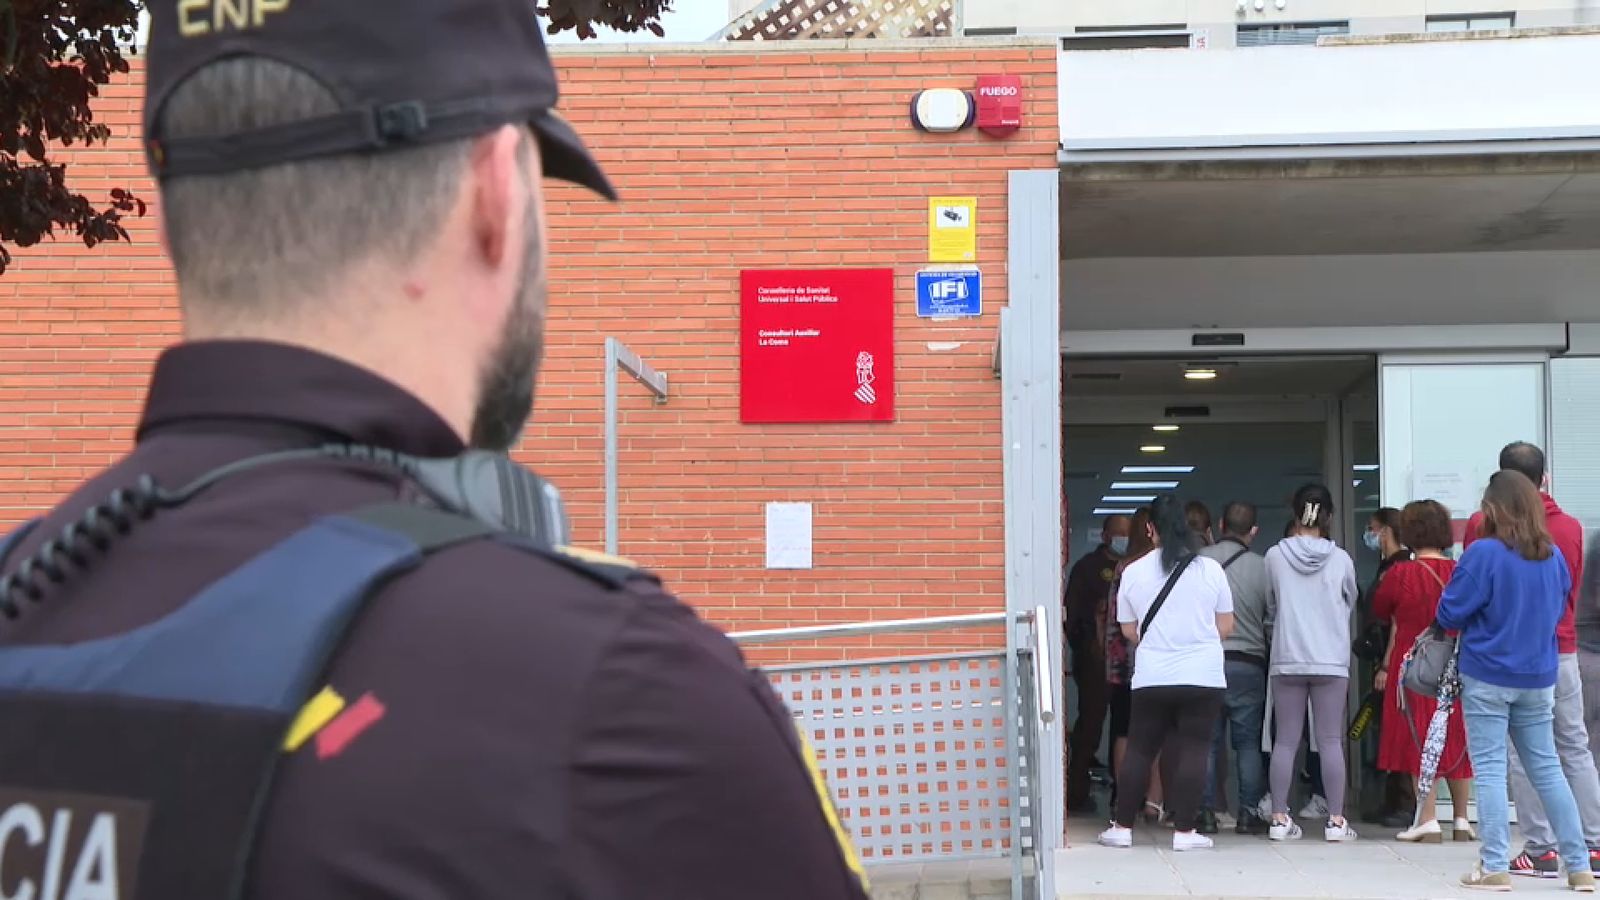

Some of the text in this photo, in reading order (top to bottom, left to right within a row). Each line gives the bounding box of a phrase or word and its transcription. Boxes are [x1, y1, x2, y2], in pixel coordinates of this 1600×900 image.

[178, 0, 290, 36] CNP
[979, 86, 1018, 96] FUEGO
[796, 286, 806, 294] de
[932, 281, 965, 298] IFI
[758, 294, 790, 303] Universal
[795, 294, 813, 303] Salut
[759, 329, 794, 338] Consultori
[768, 338, 789, 346] Coma
